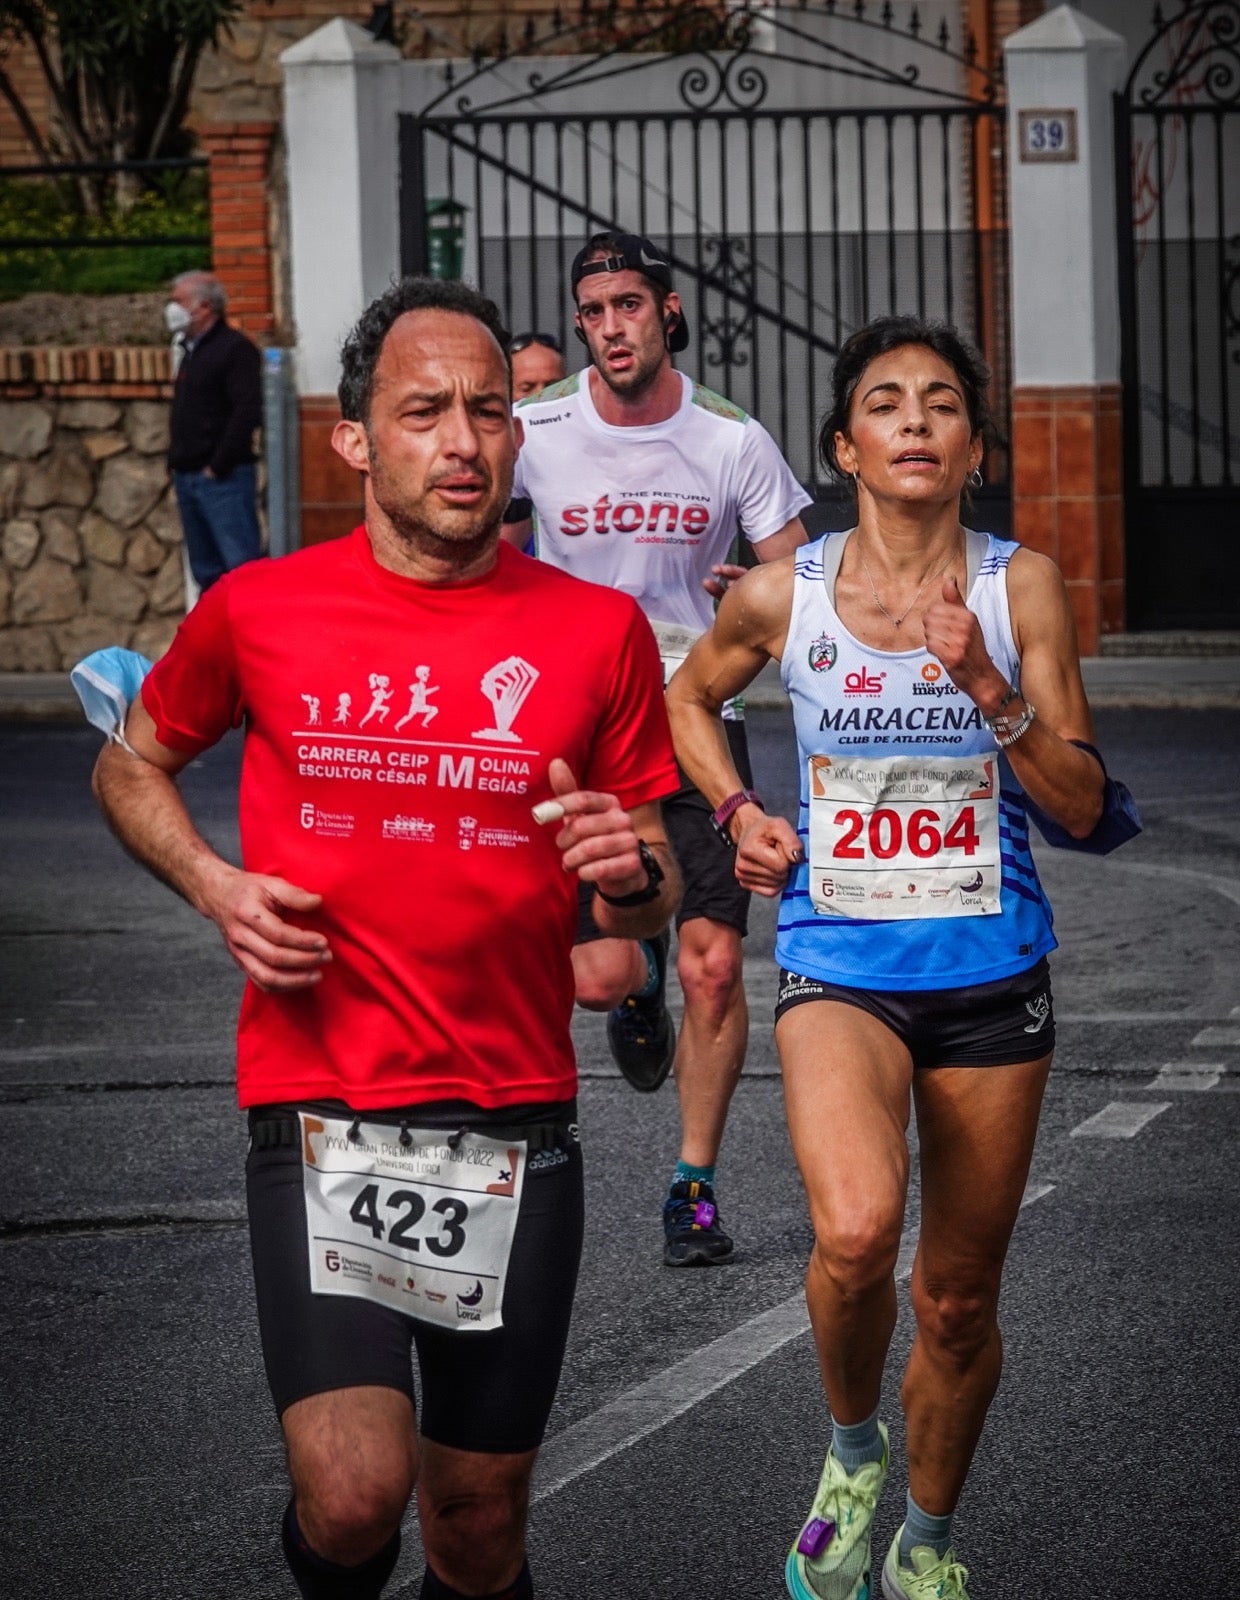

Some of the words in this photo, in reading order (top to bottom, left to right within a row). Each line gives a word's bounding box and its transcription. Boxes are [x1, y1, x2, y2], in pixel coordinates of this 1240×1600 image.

[1030, 120, 1063, 150] 39
[620, 491, 648, 499] THE
[653, 491, 711, 502] RETURN
[559, 494, 710, 536] stone
[912, 683, 959, 698] mayfo
[819, 706, 983, 732] MARACENA
[838, 735, 869, 745] CLUB
[874, 735, 889, 744] DE
[892, 734, 963, 744] ATLETISMO
[297, 745, 382, 765] CARRERA
[387, 752, 430, 768] CEIP
[479, 757, 531, 775] OLINA
[298, 764, 372, 781] ESCULTOR
[376, 767, 427, 785] CÉSAR
[951, 769, 975, 781] 2022
[478, 831, 530, 843] CHURRIANA
[832, 806, 979, 860] 2064
[467, 1148, 495, 1167] 2022
[350, 1184, 469, 1258] 423
